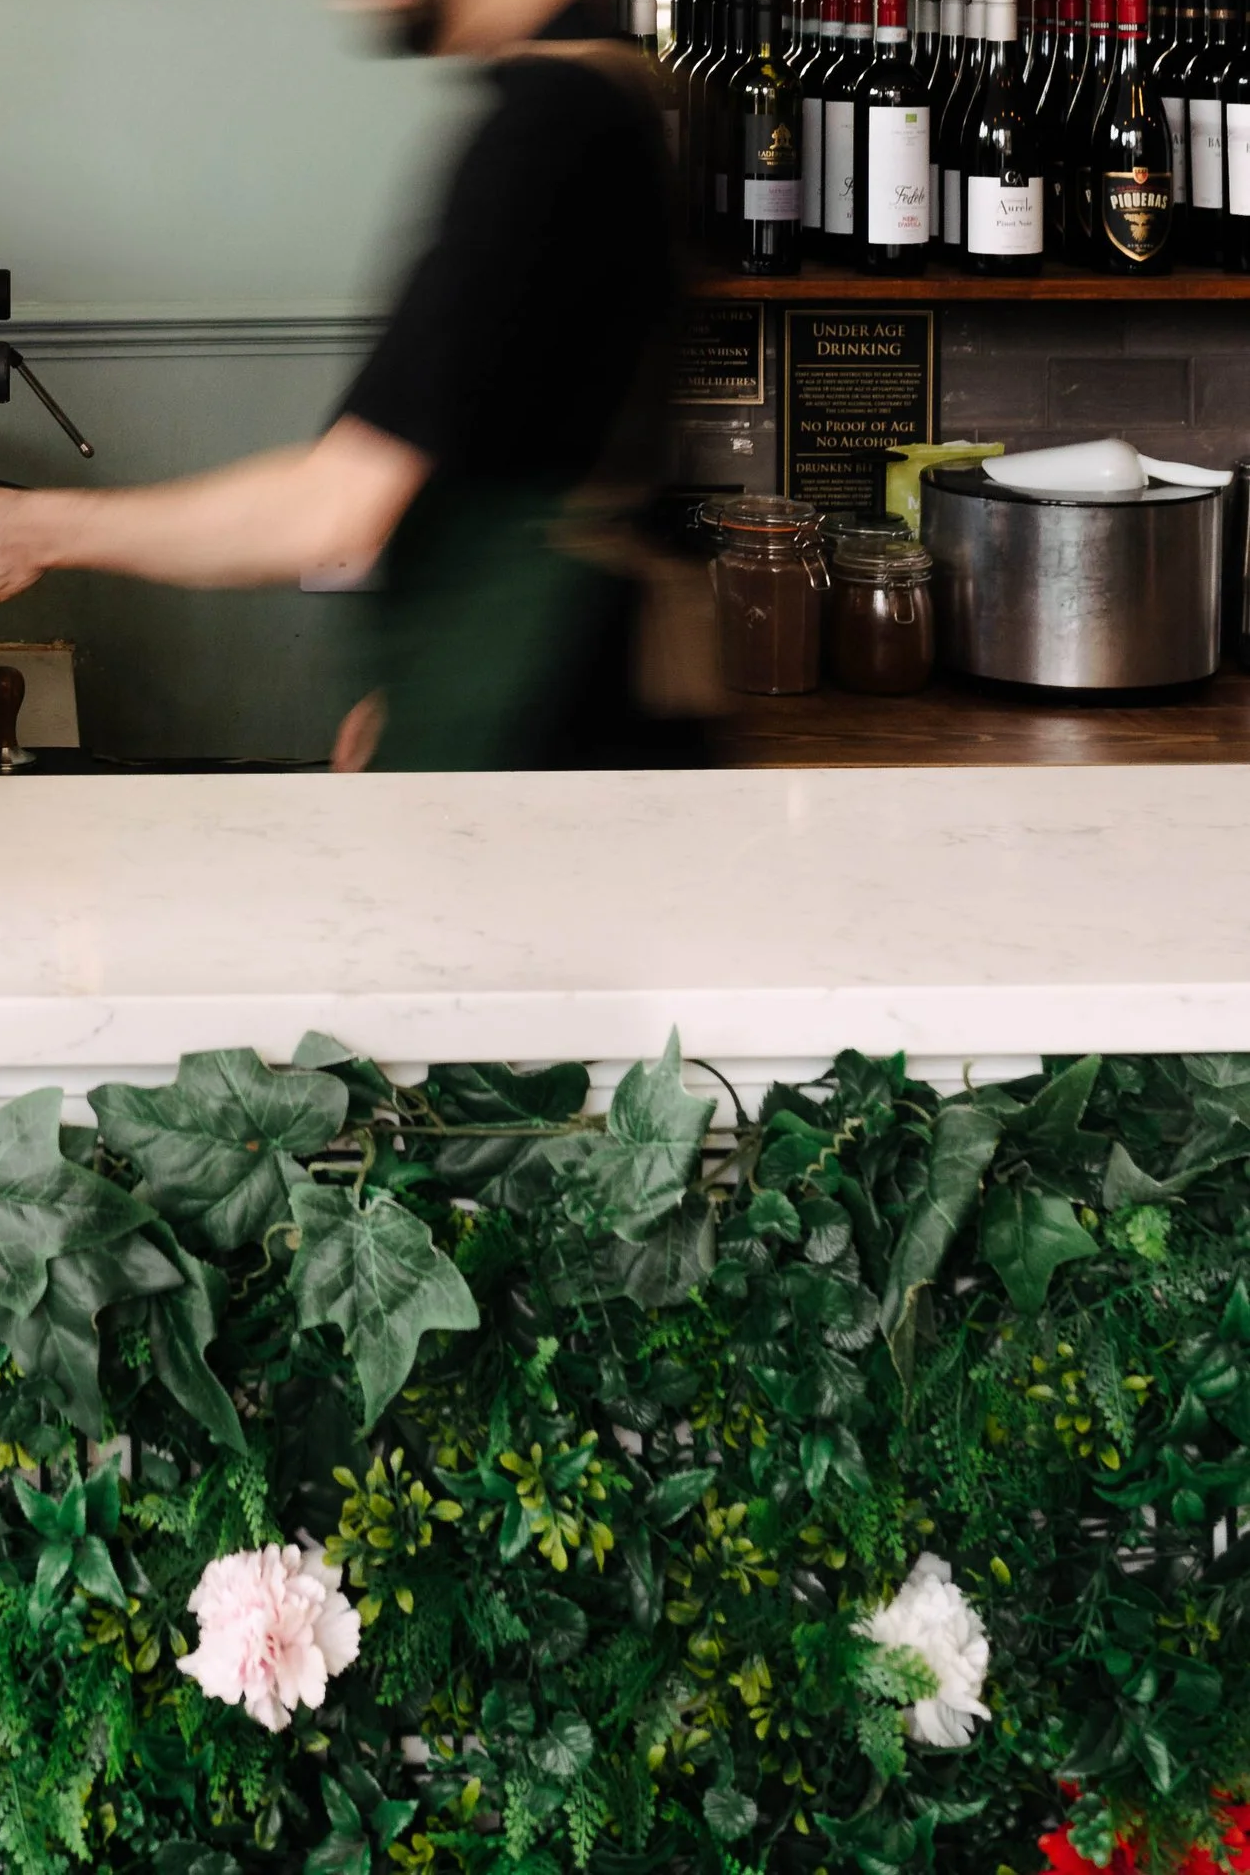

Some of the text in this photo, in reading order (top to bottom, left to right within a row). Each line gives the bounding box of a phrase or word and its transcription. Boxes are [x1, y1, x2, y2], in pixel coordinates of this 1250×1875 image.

[1110, 192, 1168, 210] PIQUERAS
[813, 322, 906, 337] UNDER AGE
[708, 348, 750, 357] WHISKY
[817, 341, 902, 356] DRINKING
[800, 421, 822, 432] NO
[825, 420, 867, 432] PROOF
[890, 421, 916, 432] AGE
[816, 436, 837, 448] NO
